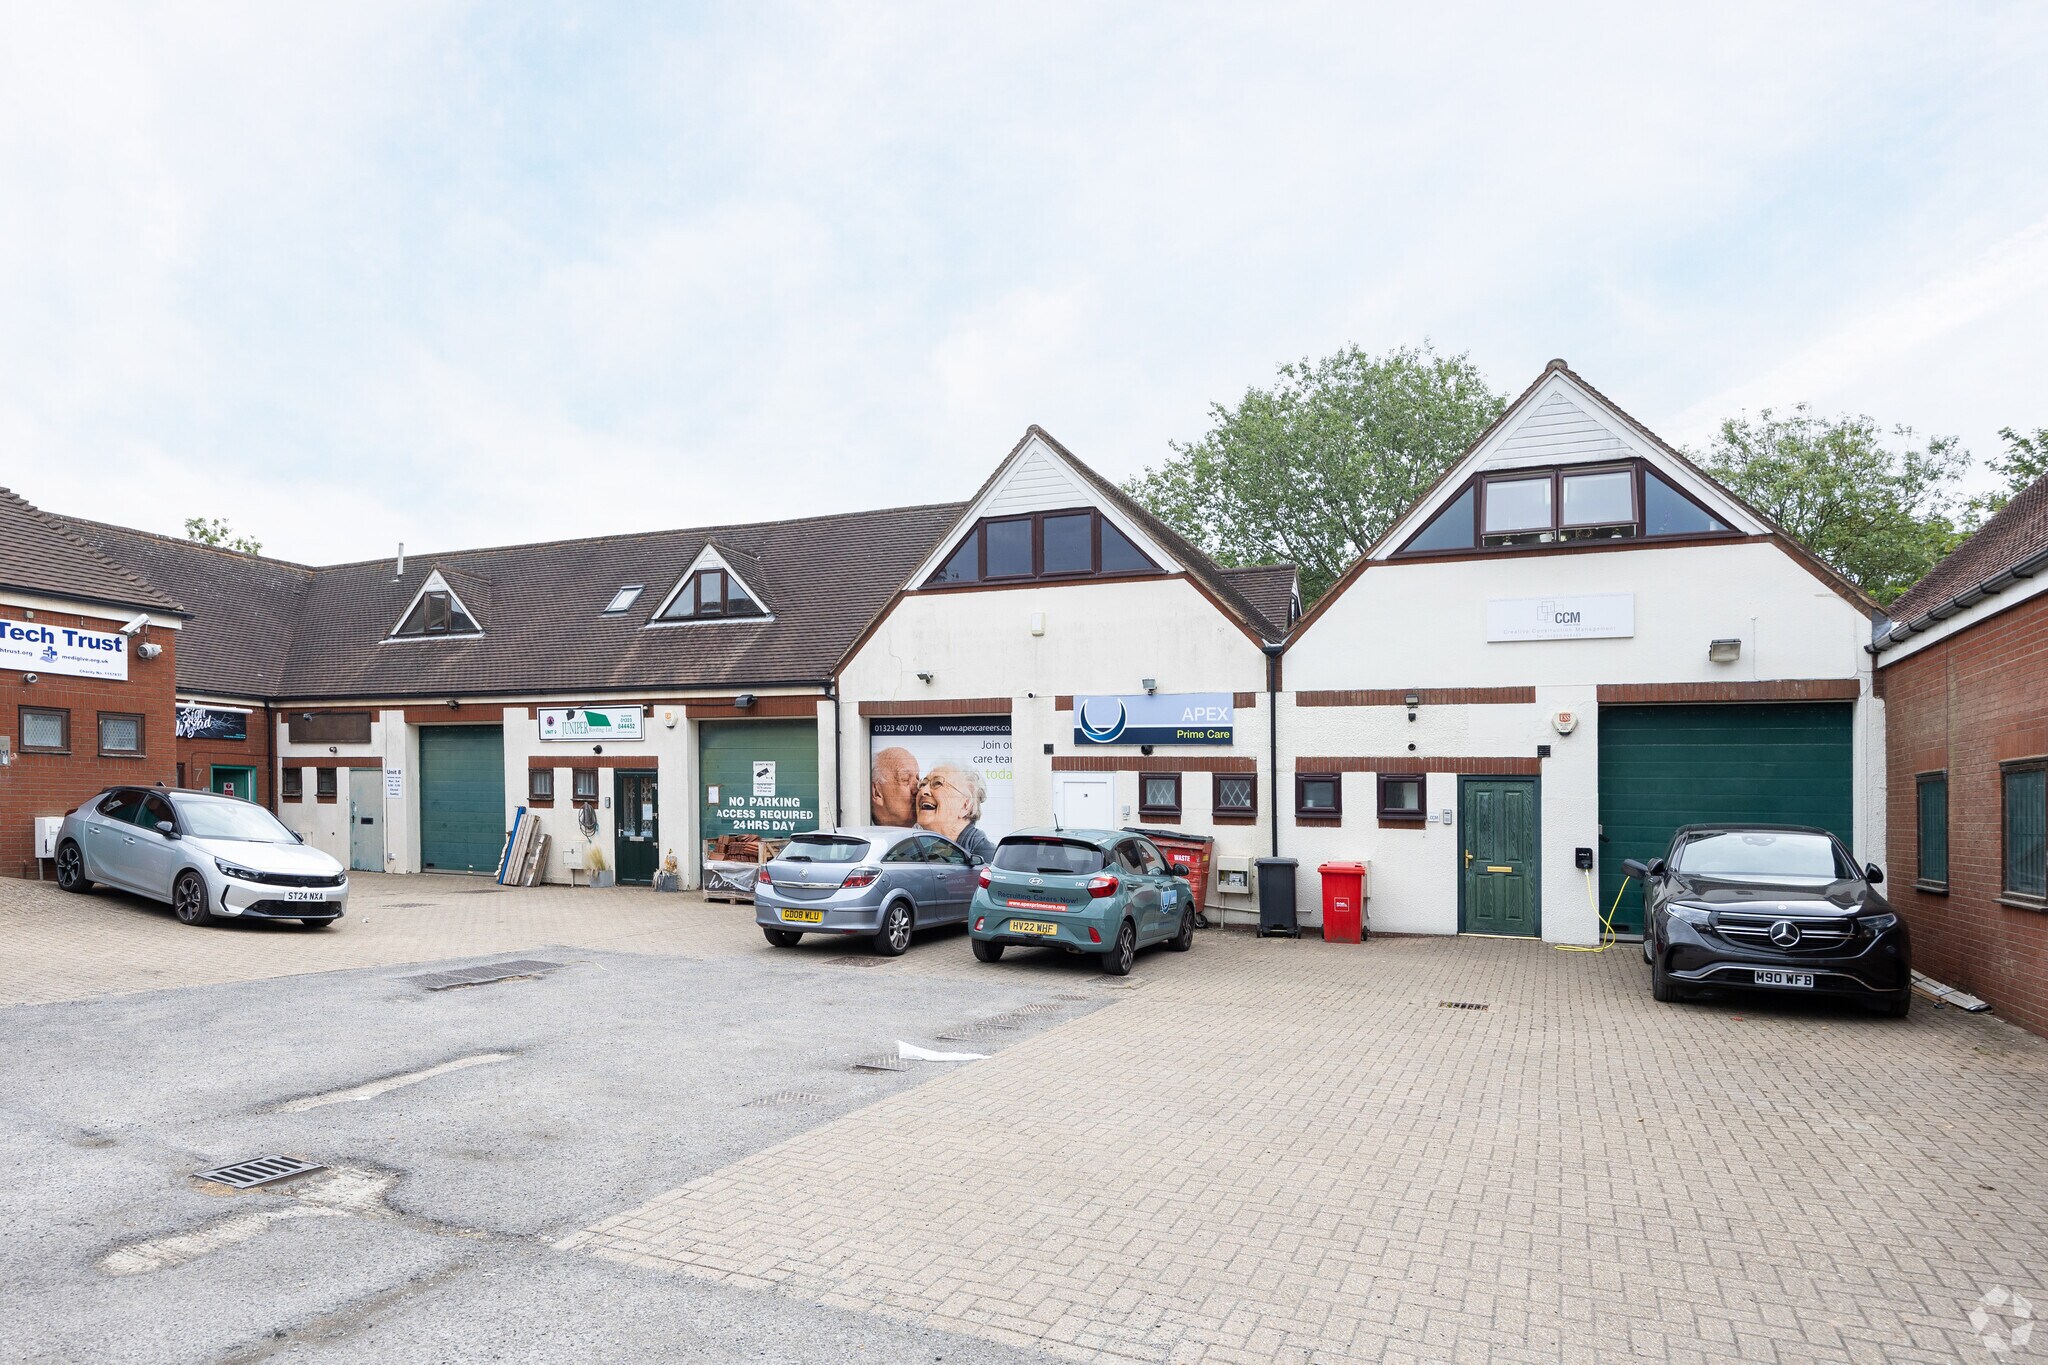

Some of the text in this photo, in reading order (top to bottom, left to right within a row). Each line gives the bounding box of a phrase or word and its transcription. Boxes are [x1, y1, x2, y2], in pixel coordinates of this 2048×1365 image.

[1554, 611, 1581, 624] CCM
[0, 621, 122, 652] Tech Trust
[1181, 706, 1229, 722] APEX
[561, 721, 589, 737] JUNIPER
[874, 724, 895, 732] 01323
[909, 724, 923, 732] 010
[1177, 729, 1230, 739] Prime Care
[981, 740, 1001, 750] Join
[972, 755, 993, 763] care
[194, 768, 203, 782] 7
[729, 797, 801, 807] NO PARKING
[716, 809, 814, 820] ACCESS REQUIRED
[733, 820, 796, 831] 24 HRS DAY
[1174, 854, 1191, 862] WASTE
[288, 891, 323, 900] ST24 NXA
[997, 890, 1031, 901] Recruiting
[1033, 894, 1058, 902] Carers
[1008, 901, 1066, 911] www.apexprimecare.org
[784, 909, 820, 920] GD08 WLU
[1012, 921, 1054, 933] HV22 WHF
[1756, 971, 1812, 986] M90 WFB
